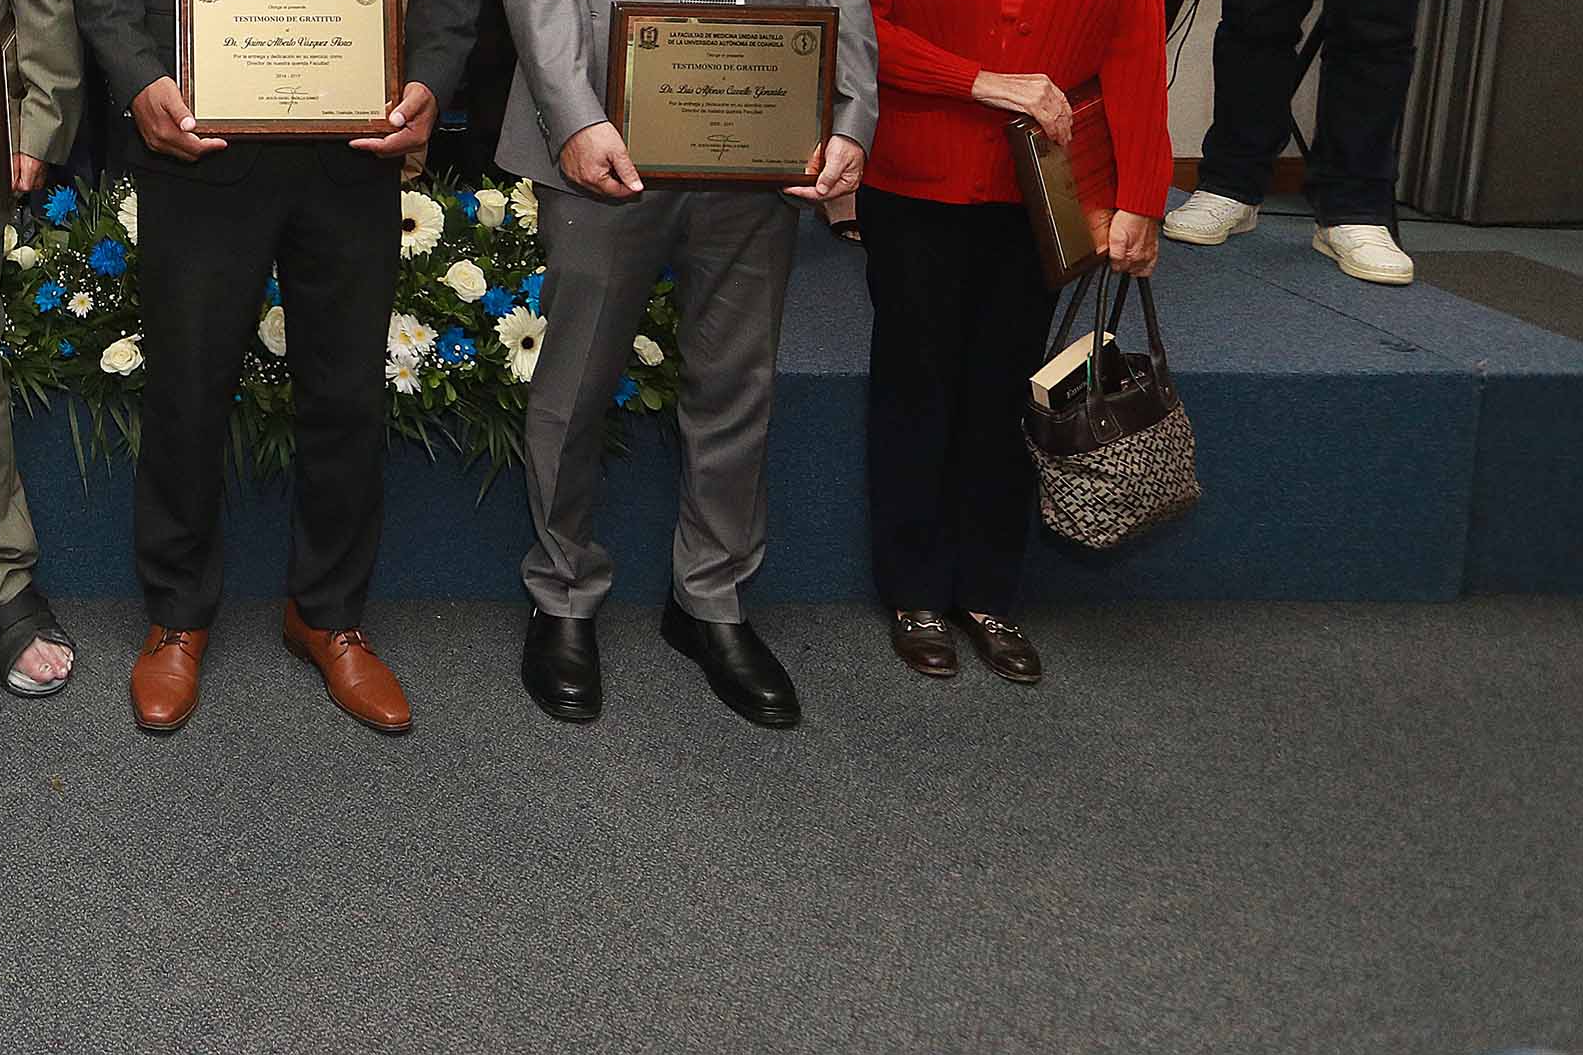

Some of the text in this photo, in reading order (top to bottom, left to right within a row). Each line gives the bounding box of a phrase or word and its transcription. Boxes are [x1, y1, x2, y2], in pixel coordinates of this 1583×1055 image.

[223, 37, 237, 46] Dr.
[672, 63, 778, 72] TESTIMONIO DE GRATITUD
